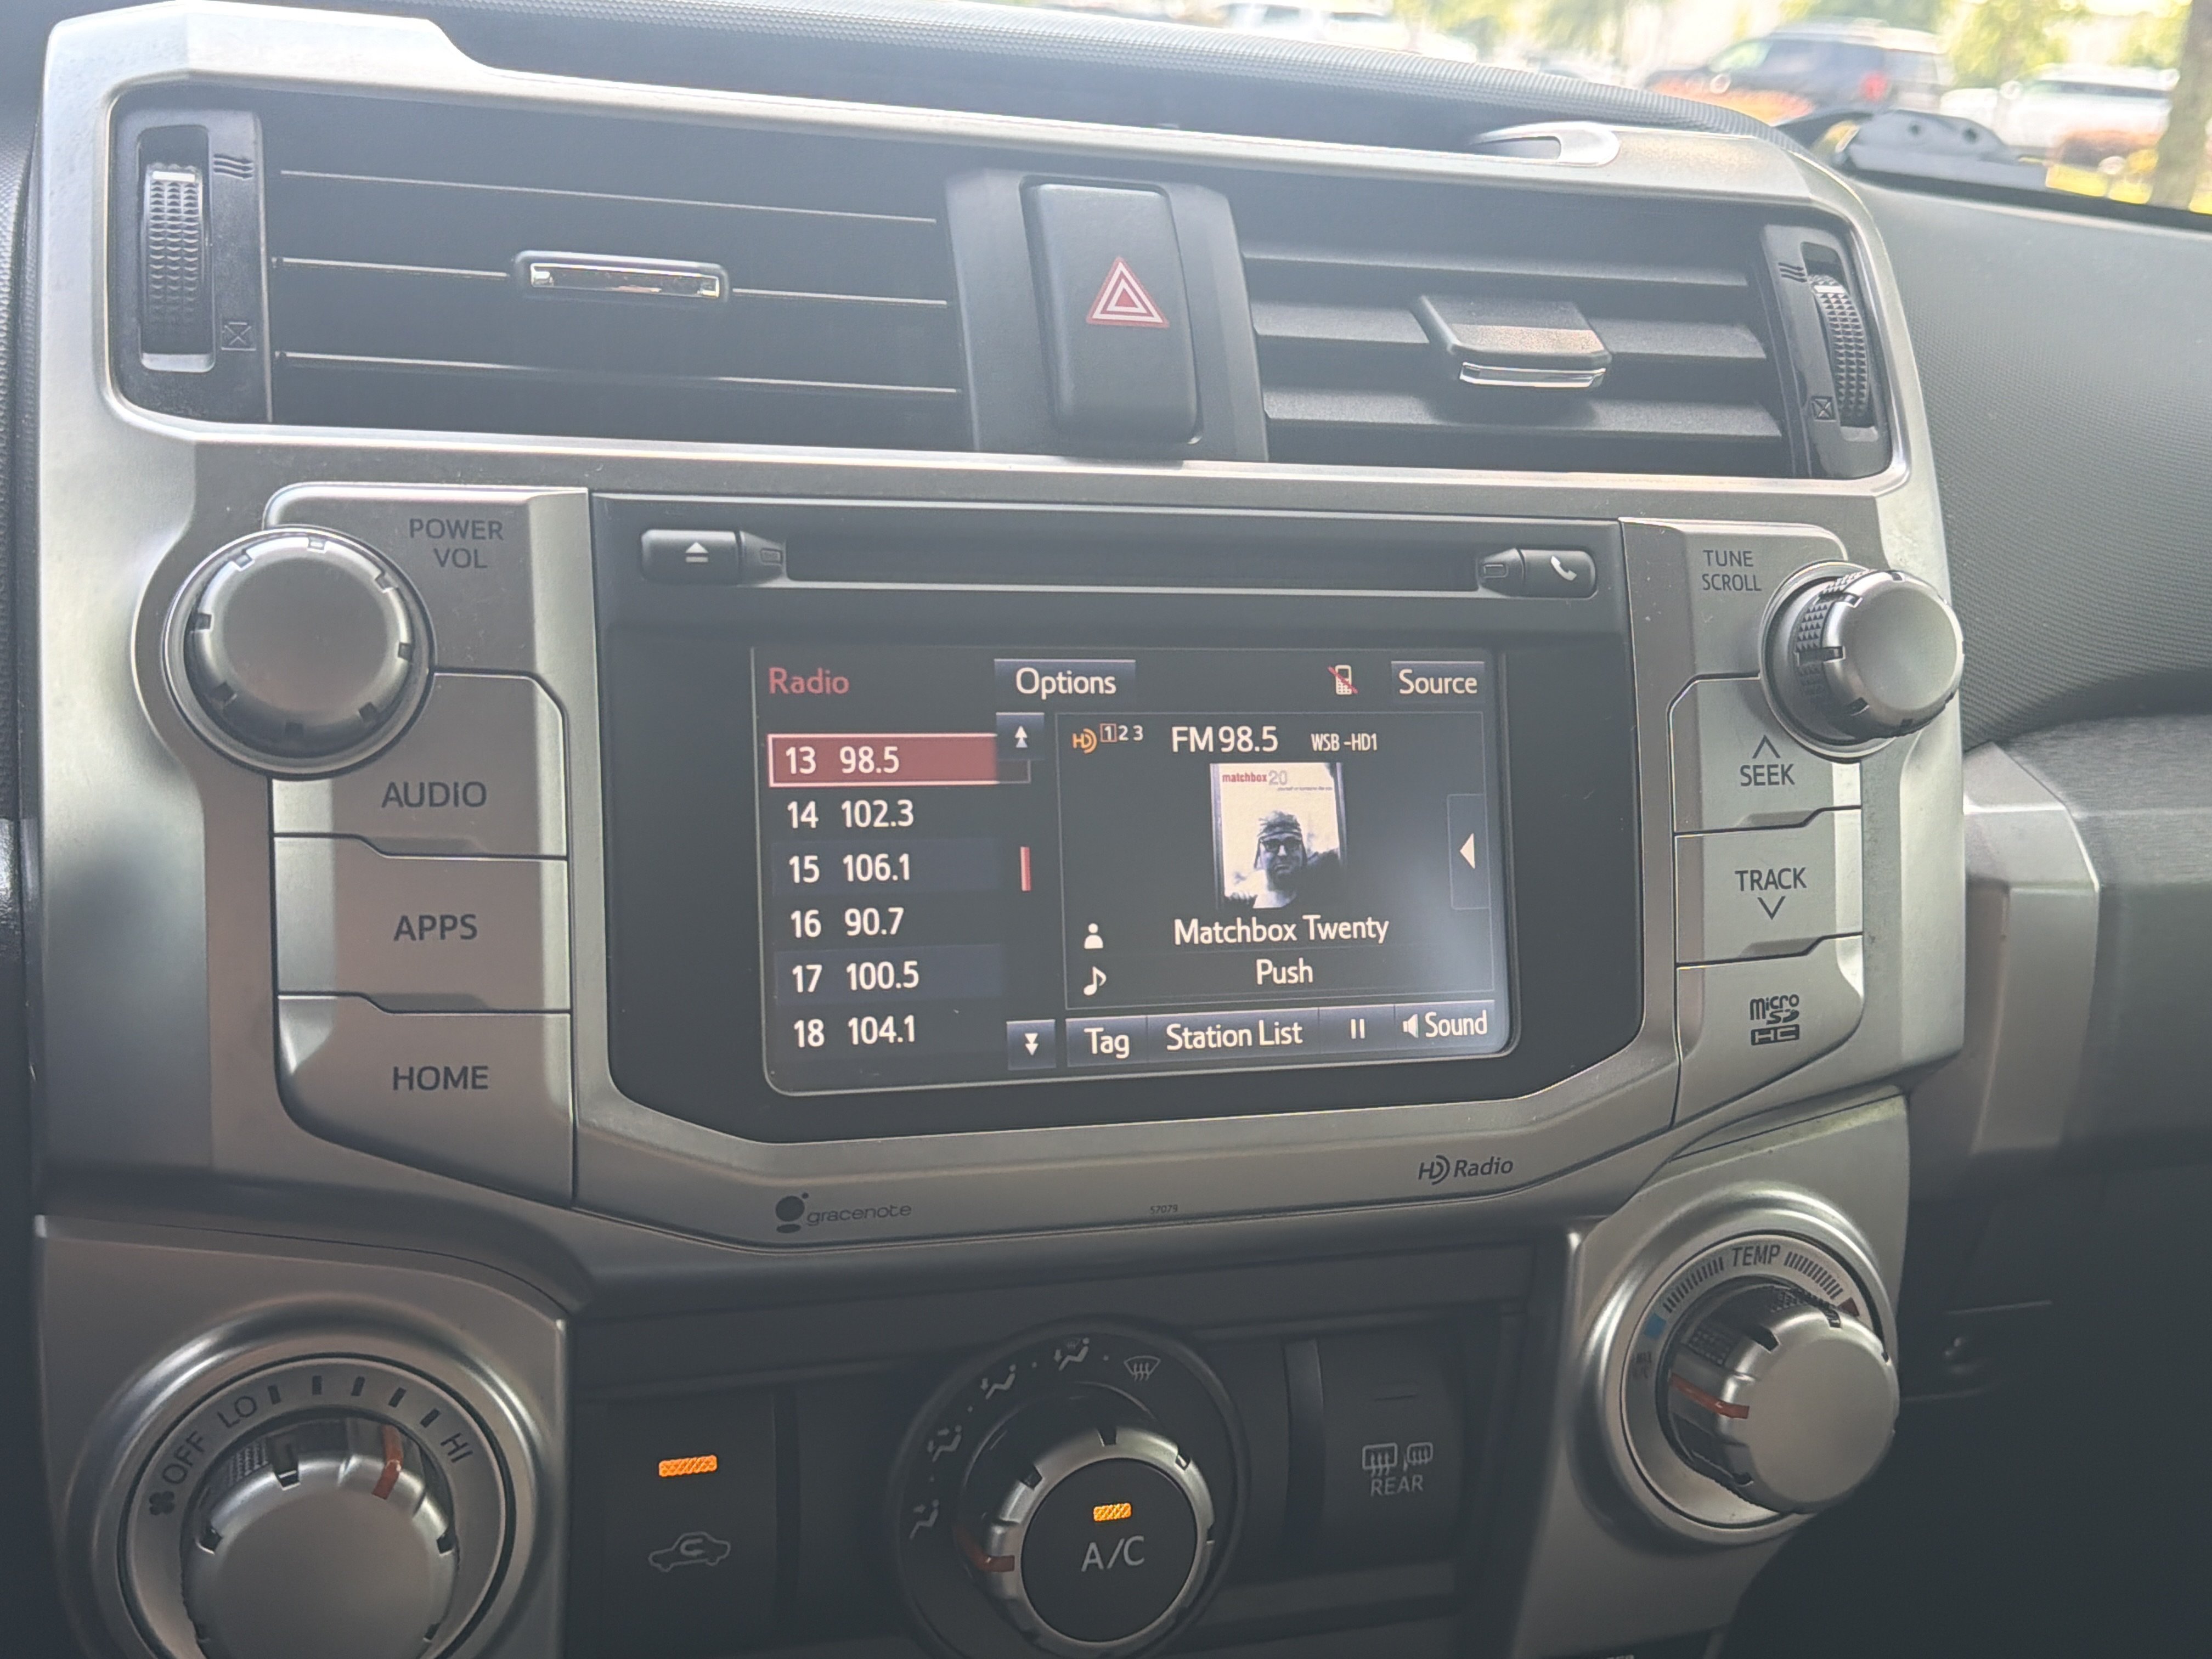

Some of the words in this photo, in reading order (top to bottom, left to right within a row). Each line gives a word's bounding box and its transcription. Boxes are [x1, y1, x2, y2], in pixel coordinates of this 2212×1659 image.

[409, 518, 504, 540] POWER
[433, 548, 488, 568] VOL
[1702, 550, 1753, 567] TUNE
[1702, 573, 1762, 591] SCROLL
[770, 668, 850, 694] Radio
[1015, 667, 1116, 699] Options
[1399, 669, 1477, 694] Source
[786, 746, 816, 774] 13
[839, 746, 900, 774] 98.5
[1222, 772, 1267, 782] matchbox
[1268, 770, 1288, 785] 20
[1740, 764, 1795, 786] SEEK
[381, 781, 487, 808] AUDIO
[787, 801, 819, 828] 14
[841, 799, 914, 828] 102.3
[789, 855, 820, 883] 15
[843, 853, 910, 882] 106.1
[1735, 867, 1807, 891] TRACK
[393, 915, 478, 941] APPS
[791, 910, 821, 938] 16
[844, 907, 904, 935] 90.7
[1175, 918, 1296, 945] Matchbox
[1304, 915, 1389, 943] Twenty
[792, 964, 822, 993] 17
[847, 961, 919, 991] 100.5
[1256, 958, 1313, 985] Push
[794, 1019, 825, 1048] 18
[848, 1015, 915, 1045] 104.1
[1166, 1023, 1252, 1051] Station
[1259, 1020, 1303, 1045] List
[1425, 1010, 1487, 1038] Sound
[1084, 1027, 1129, 1059] Tag
[393, 1066, 488, 1091] HOME
[1454, 1156, 1513, 1177] Radio
[807, 1205, 912, 1226] gracenote
[1150, 1204, 1178, 1215] 57079
[1731, 1244, 1781, 1267] TEMP
[217, 1396, 257, 1429] LO
[162, 1430, 206, 1485] OFF
[441, 1432, 473, 1463] HI
[1370, 1474, 1423, 1496] REAR
[1081, 1536, 1144, 1572] A/C
